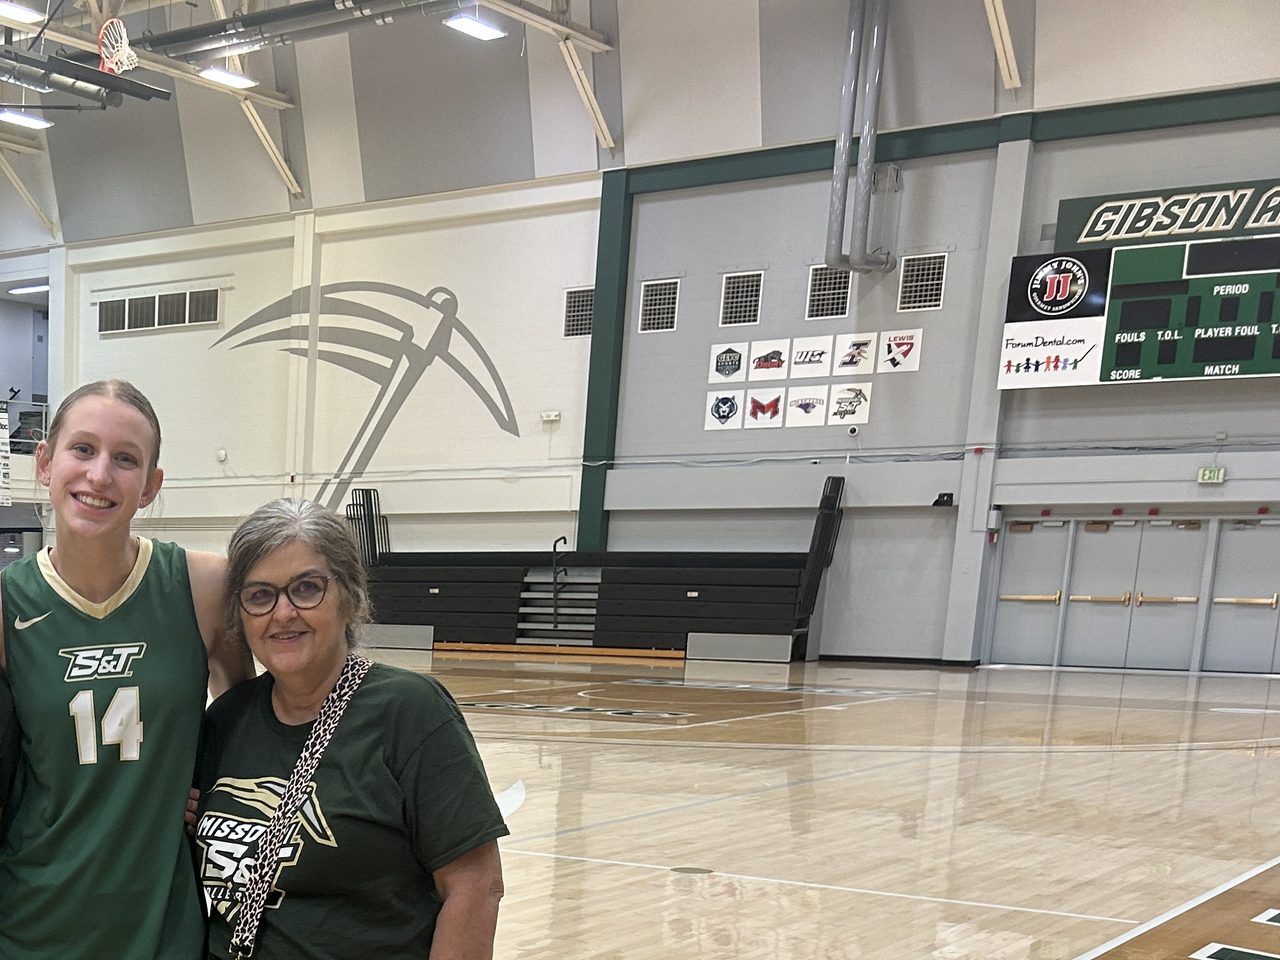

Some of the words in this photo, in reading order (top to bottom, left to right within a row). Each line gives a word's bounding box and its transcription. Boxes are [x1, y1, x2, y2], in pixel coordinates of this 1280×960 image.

[1077, 187, 1255, 244] GIBSON
[1032, 261, 1059, 289] JIMMY
[1061, 261, 1085, 285] JOHN'S
[1043, 273, 1073, 302] JJ
[1213, 284, 1249, 296] PERIOD
[1115, 331, 1146, 343] FOULS
[1157, 330, 1183, 341] T.O.L.
[1194, 326, 1232, 338] PLAYER
[1235, 325, 1260, 336] FOUL
[1005, 336, 1085, 349] ForumDental.com
[794, 350, 826, 365] UIS
[1110, 369, 1141, 380] SCORE
[1204, 364, 1240, 376] MATCH
[1202, 468, 1221, 481] EXIT
[67, 644, 143, 680] S&T
[69, 686, 143, 765] 14
